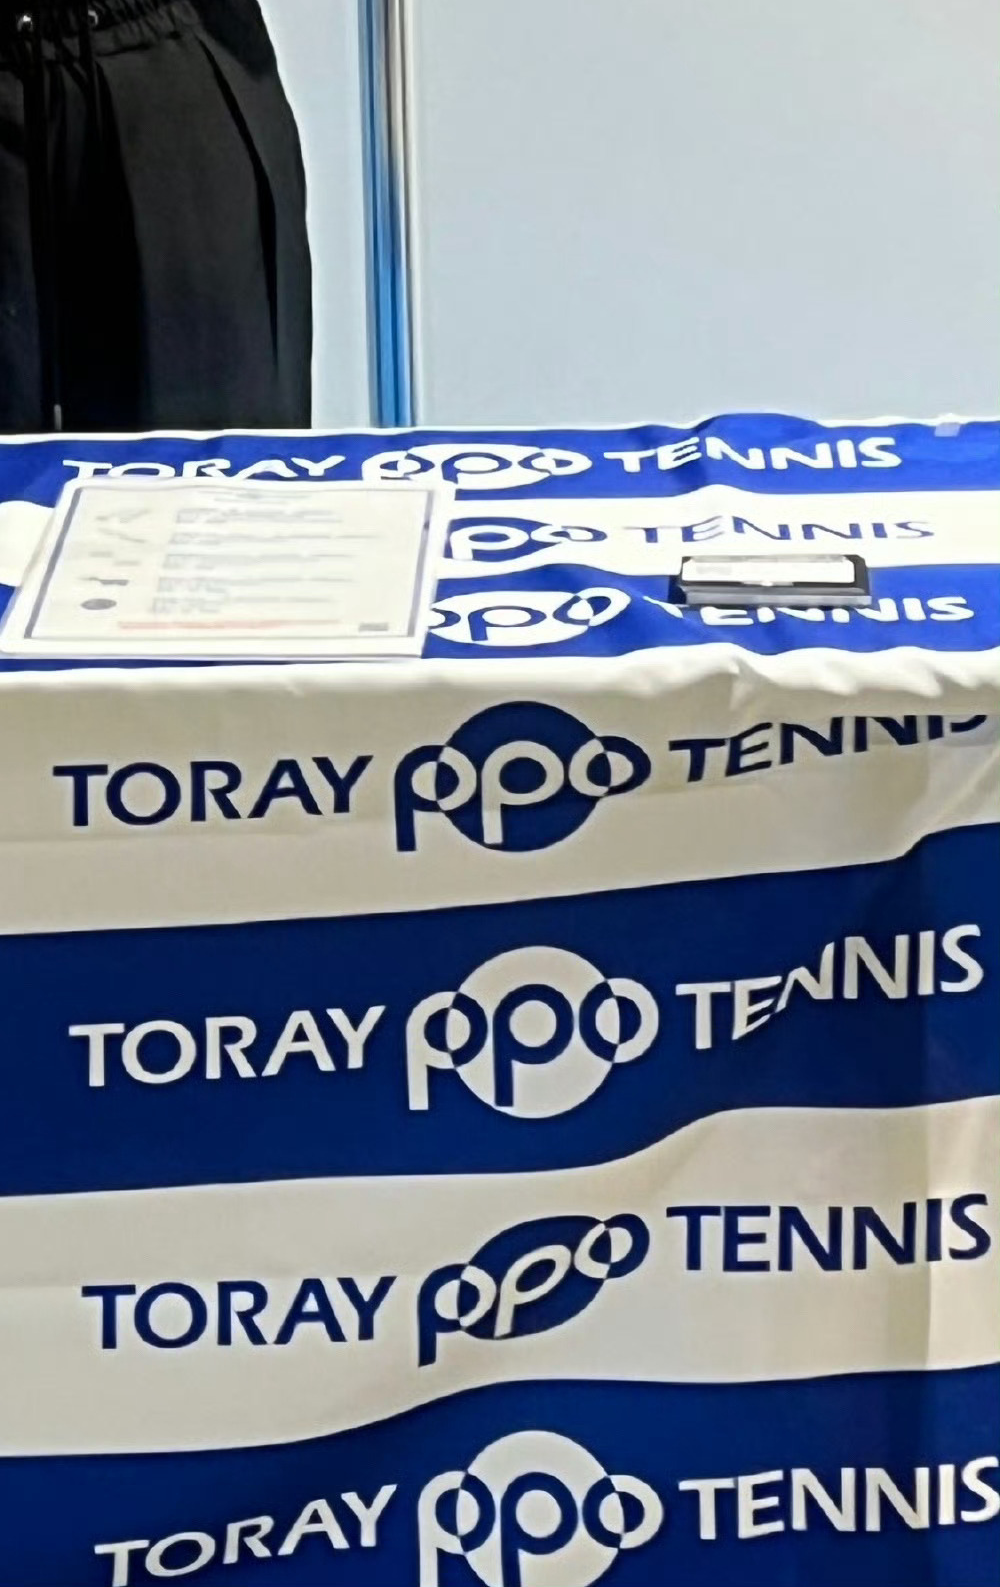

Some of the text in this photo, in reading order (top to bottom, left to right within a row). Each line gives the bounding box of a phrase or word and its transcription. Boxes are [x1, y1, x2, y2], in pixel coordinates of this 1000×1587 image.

[62, 455, 345, 479] TORAY
[603, 436, 902, 473] TENNIS
[622, 515, 934, 543] TENNIS
[53, 755, 373, 827] TORAY
[69, 1005, 387, 1088] TORAY
[675, 924, 983, 1050] TENNIS
[82, 1276, 396, 1350] TORAY
[666, 1194, 991, 1273] TENNIS
[94, 1484, 398, 1587] TORAY
[678, 1456, 1000, 1540] TENNIS
